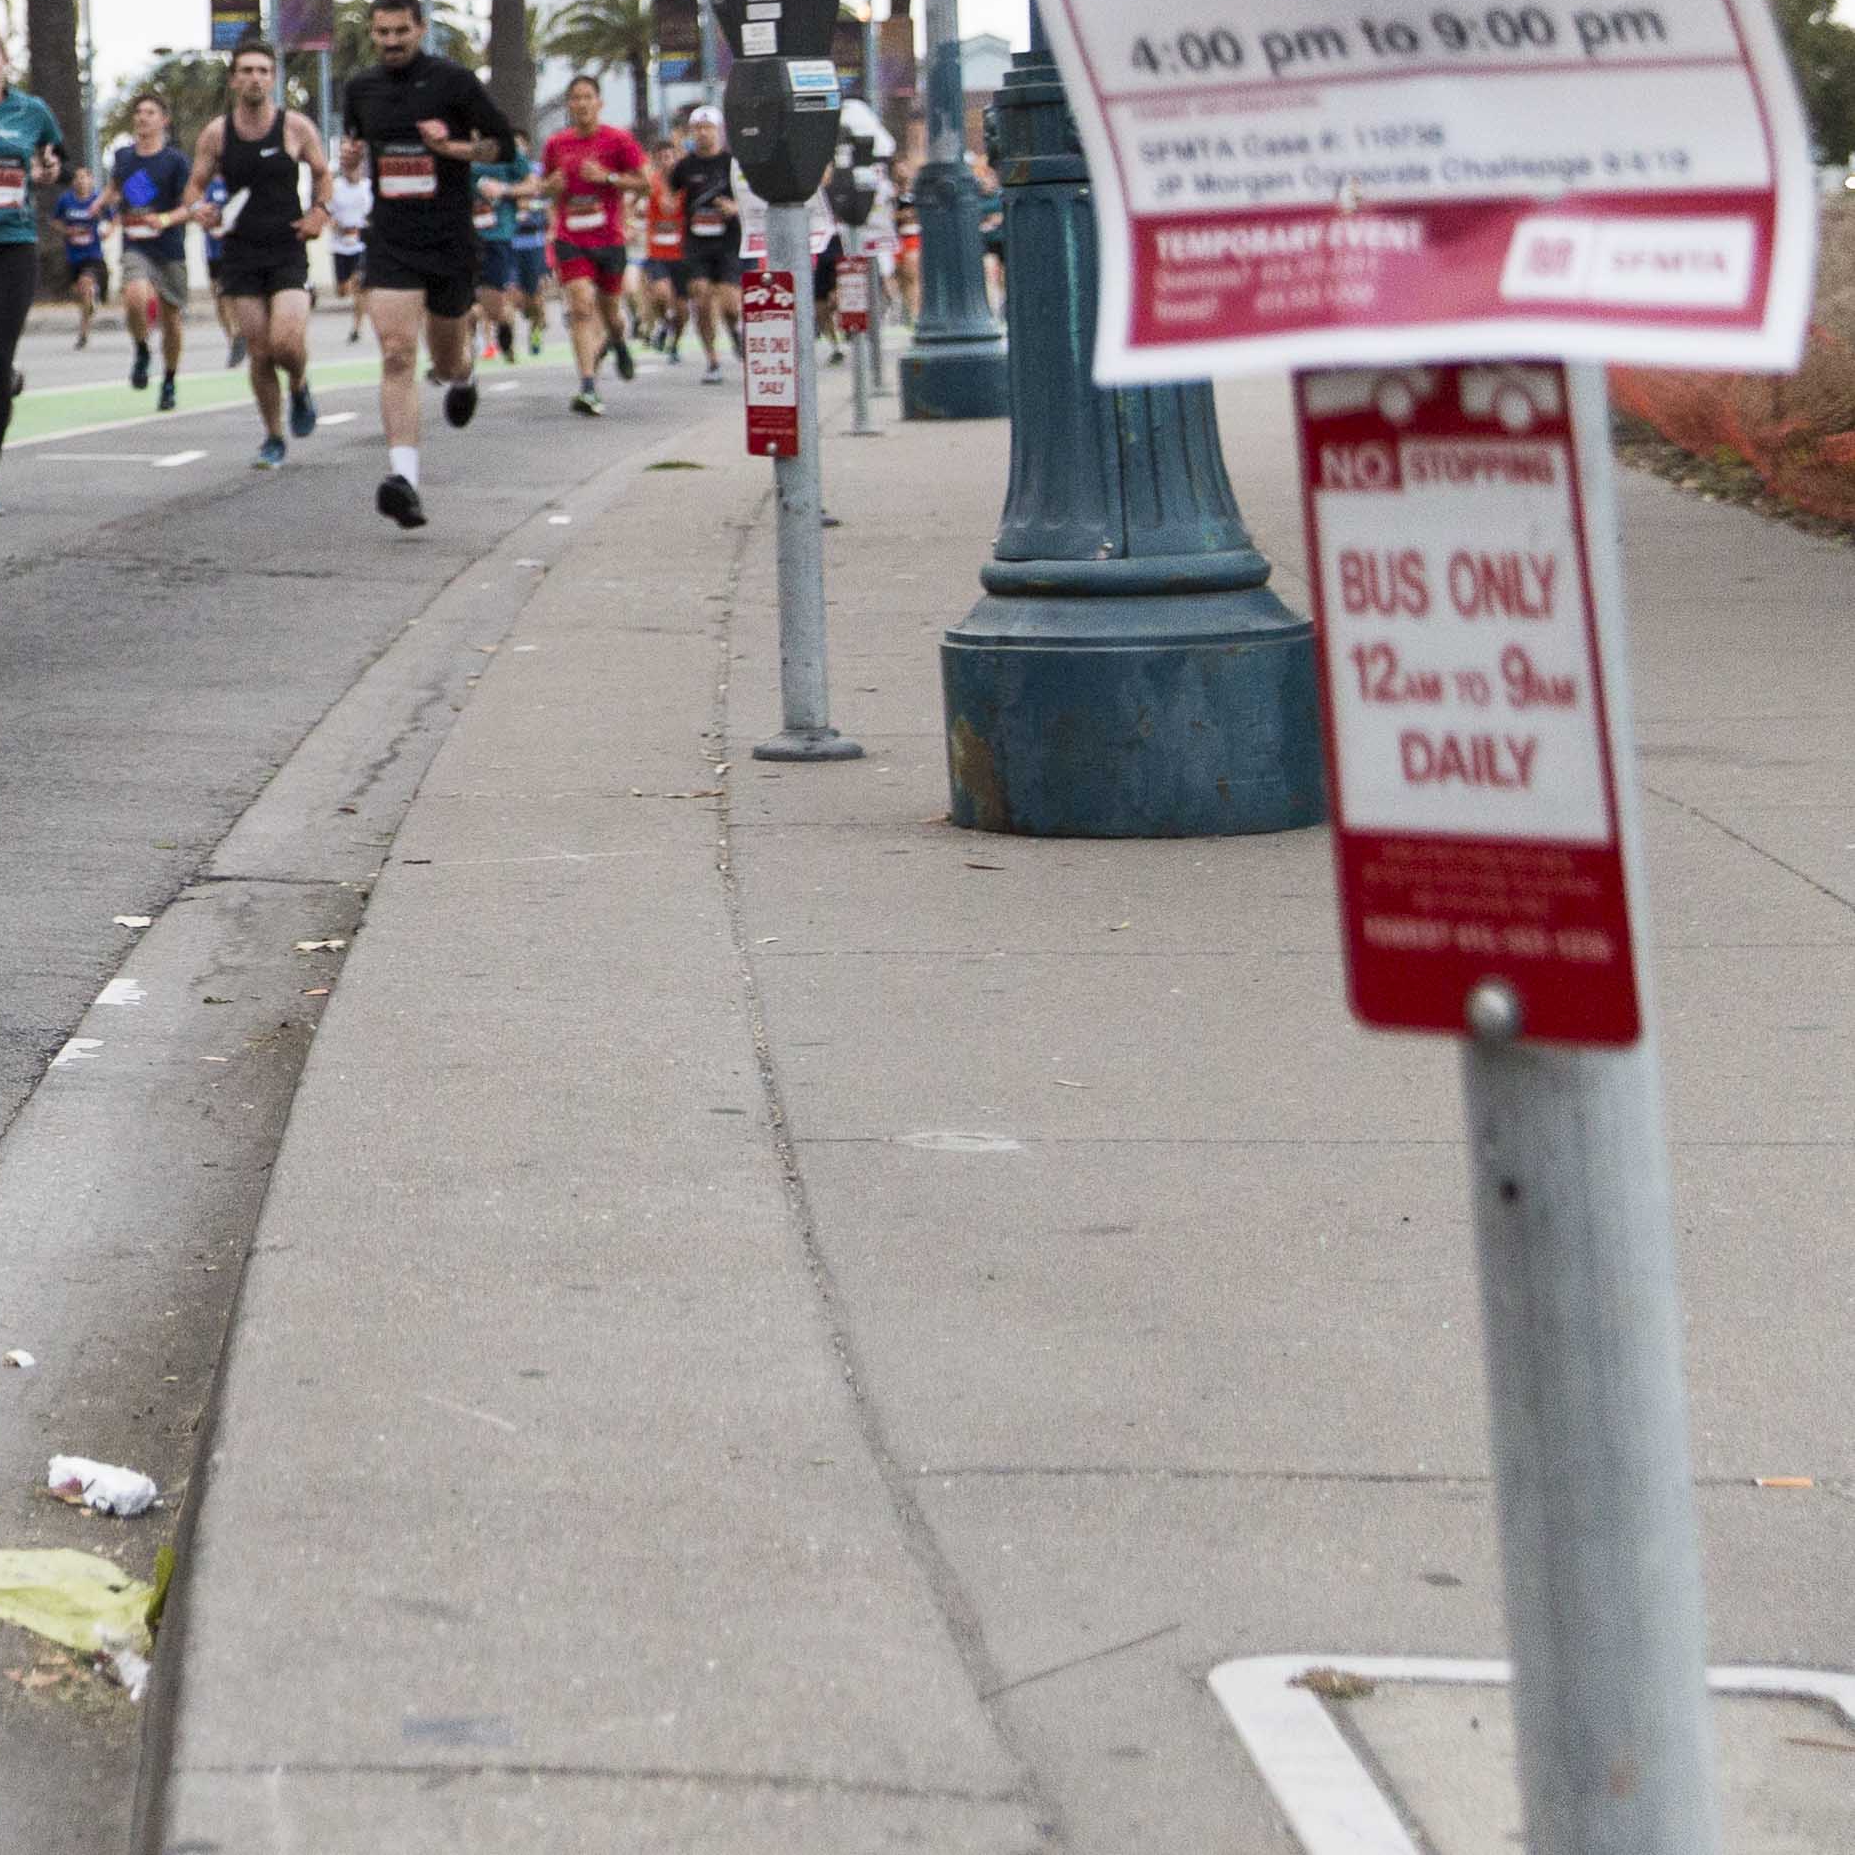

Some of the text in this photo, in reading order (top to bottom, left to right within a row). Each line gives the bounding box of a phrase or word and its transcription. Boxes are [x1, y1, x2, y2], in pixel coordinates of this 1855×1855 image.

[1130, 3, 1668, 79] 4:00 pm to 9:00 pm
[1321, 444, 1554, 490] NO STOPPING
[1340, 548, 1556, 621] BUS ONLY
[1400, 728, 1539, 788] DAILY
